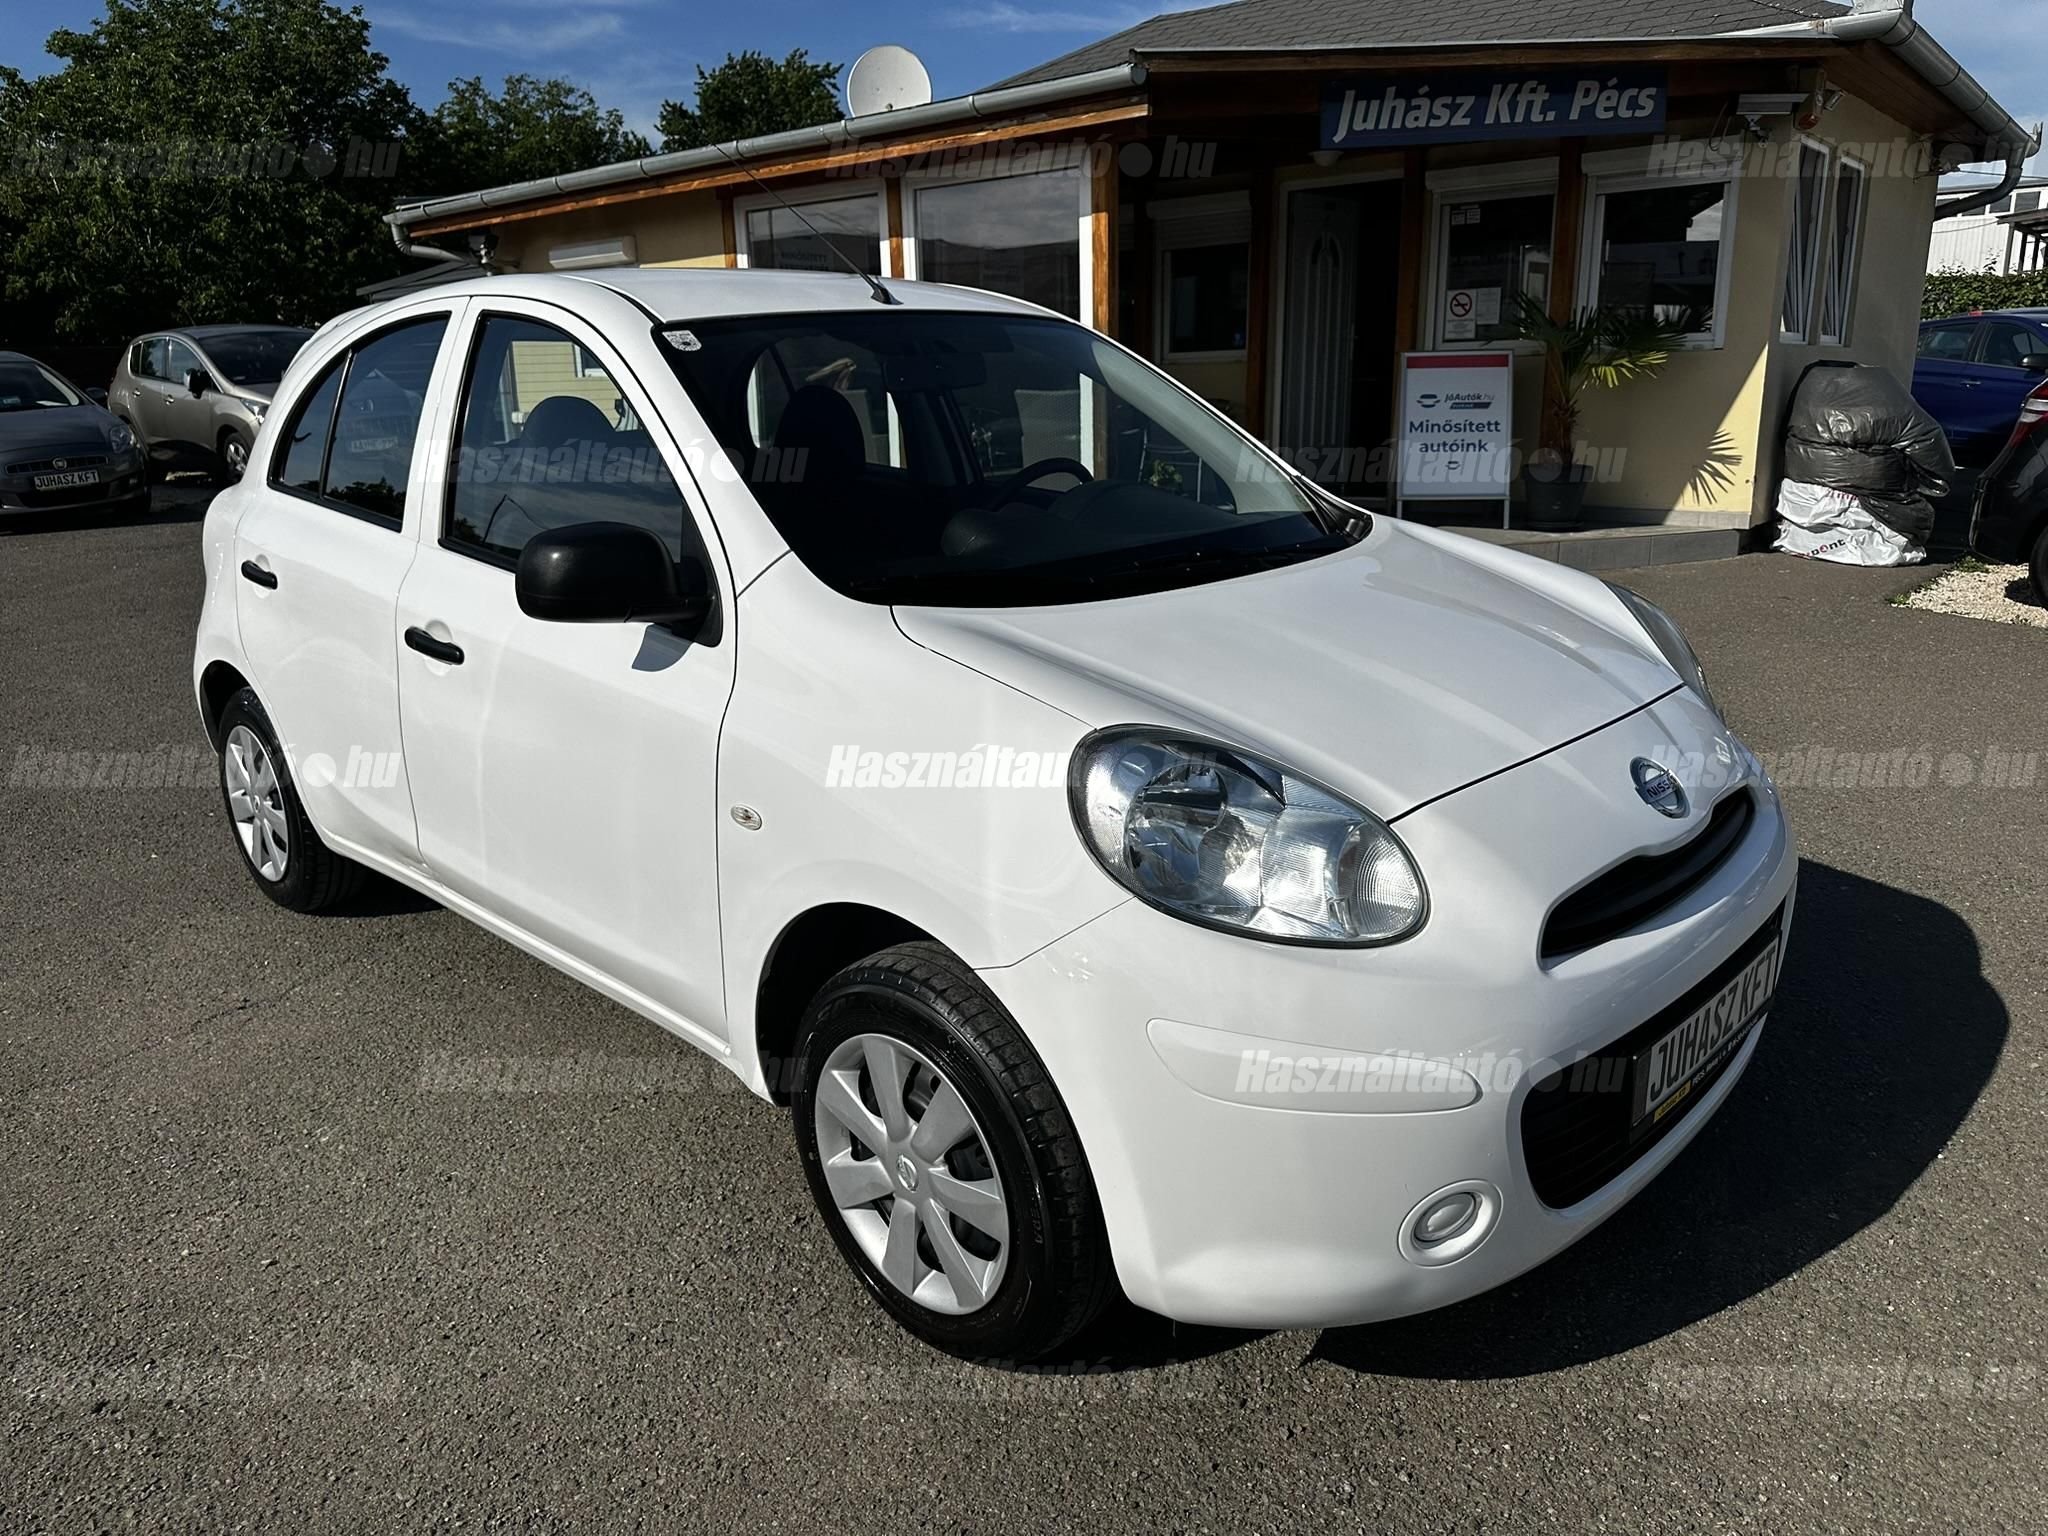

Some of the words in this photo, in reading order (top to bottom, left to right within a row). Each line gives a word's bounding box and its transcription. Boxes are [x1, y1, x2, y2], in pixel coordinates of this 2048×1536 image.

[1332, 85, 1475, 144] Juhász
[1484, 81, 1556, 124] Kft.
[1569, 77, 1657, 120] Pécs
[1409, 420, 1501, 433] Minősített
[1419, 439, 1489, 453] autóink
[37, 473, 76, 488] JUHASZ
[80, 471, 97, 483] KFT
[1650, 981, 1739, 1102] JUHASZ
[1739, 944, 1776, 1023] KFT
